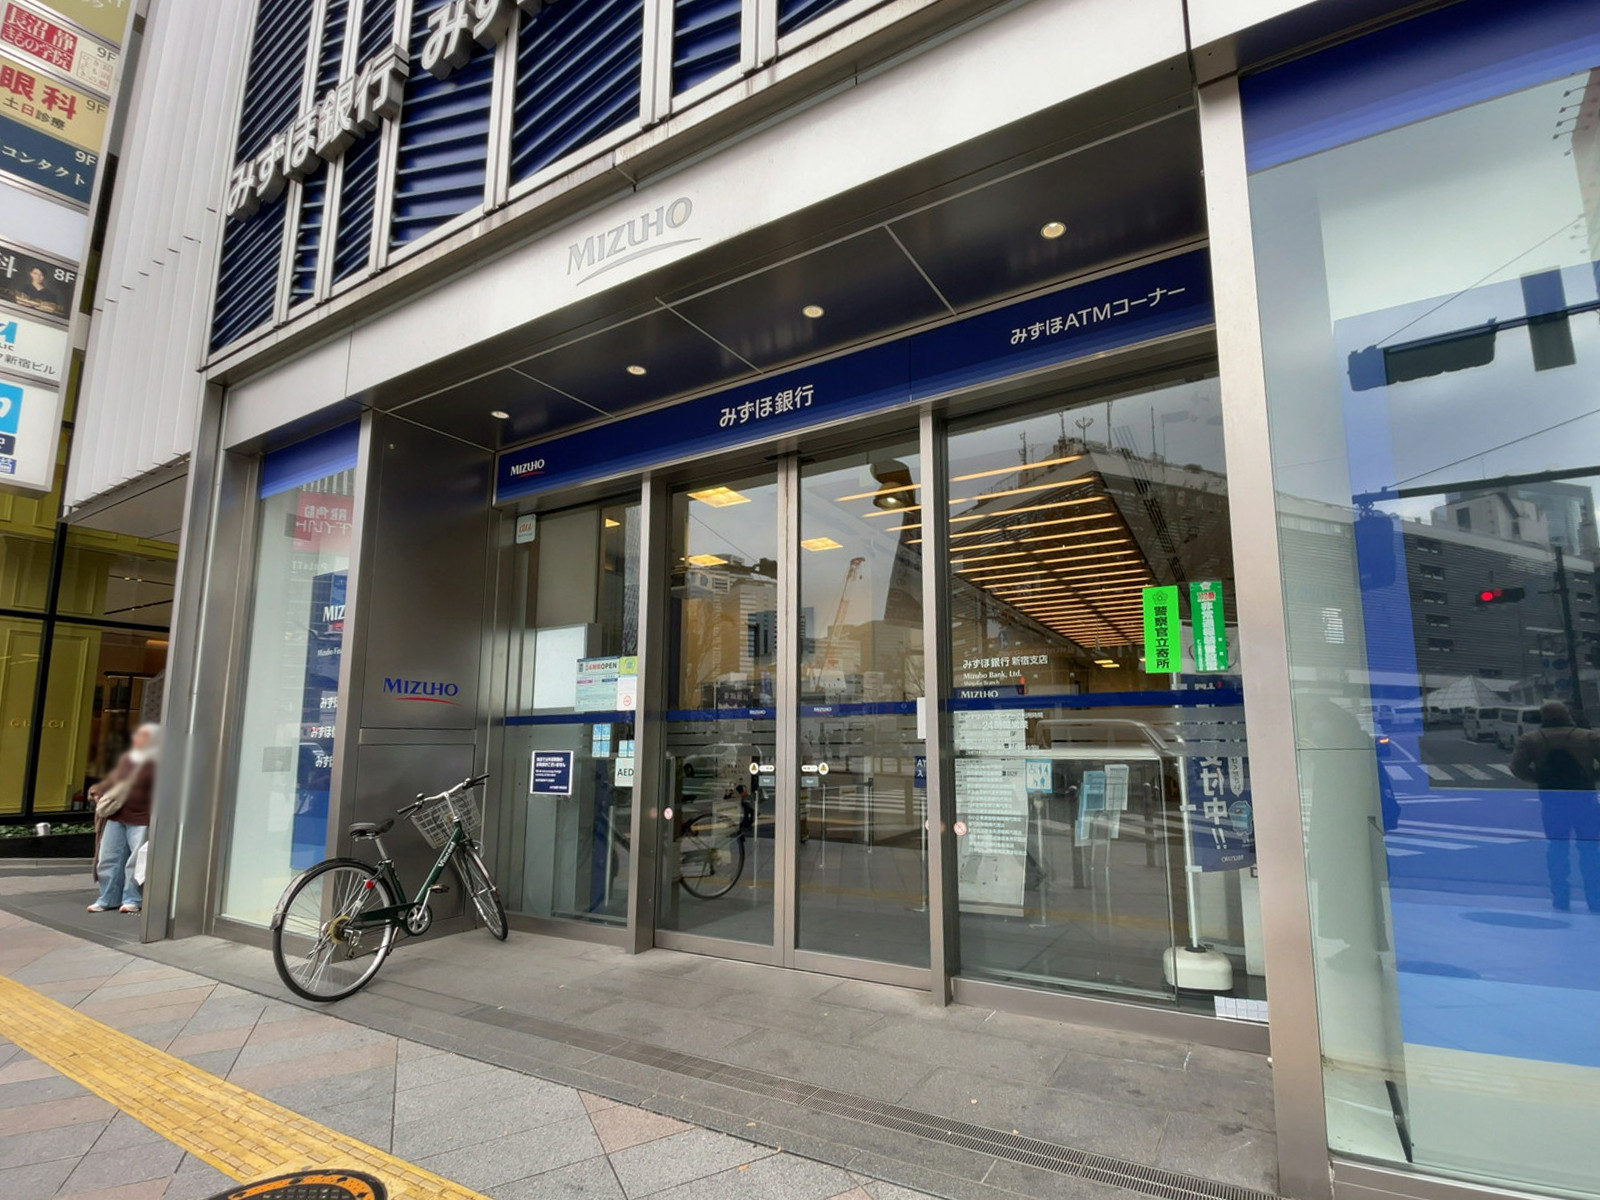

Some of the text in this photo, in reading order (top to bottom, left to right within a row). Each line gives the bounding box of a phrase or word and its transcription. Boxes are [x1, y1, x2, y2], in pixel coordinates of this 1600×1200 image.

[96, 46, 116, 62] 9F
[0, 65, 77, 120] 眼科
[2, 96, 66, 131] 土日診療
[86, 99, 106, 115] 9F
[227, 45, 409, 220] みずほ銀行
[2, 144, 86, 186] コンタクト
[74, 150, 97, 166] 9F
[566, 197, 694, 276] MIZUHO
[53, 268, 75, 283] 8F
[1010, 287, 1186, 345] みずほATMコーナー
[719, 384, 815, 428] みずほ銀行
[510, 459, 545, 476] MIZUHO
[1154, 605, 1170, 669] 警察官立寄所
[963, 654, 1048, 669] みずほ銀行 新宿支店
[963, 669, 1023, 680] Mizuho Bank, Ltd.
[383, 677, 458, 697] MIZUHO
[961, 690, 999, 699] MIZUHO
[9, 718, 65, 728] GUCI
[310, 726, 336, 739] みずほ
[617, 768, 635, 777] AED
